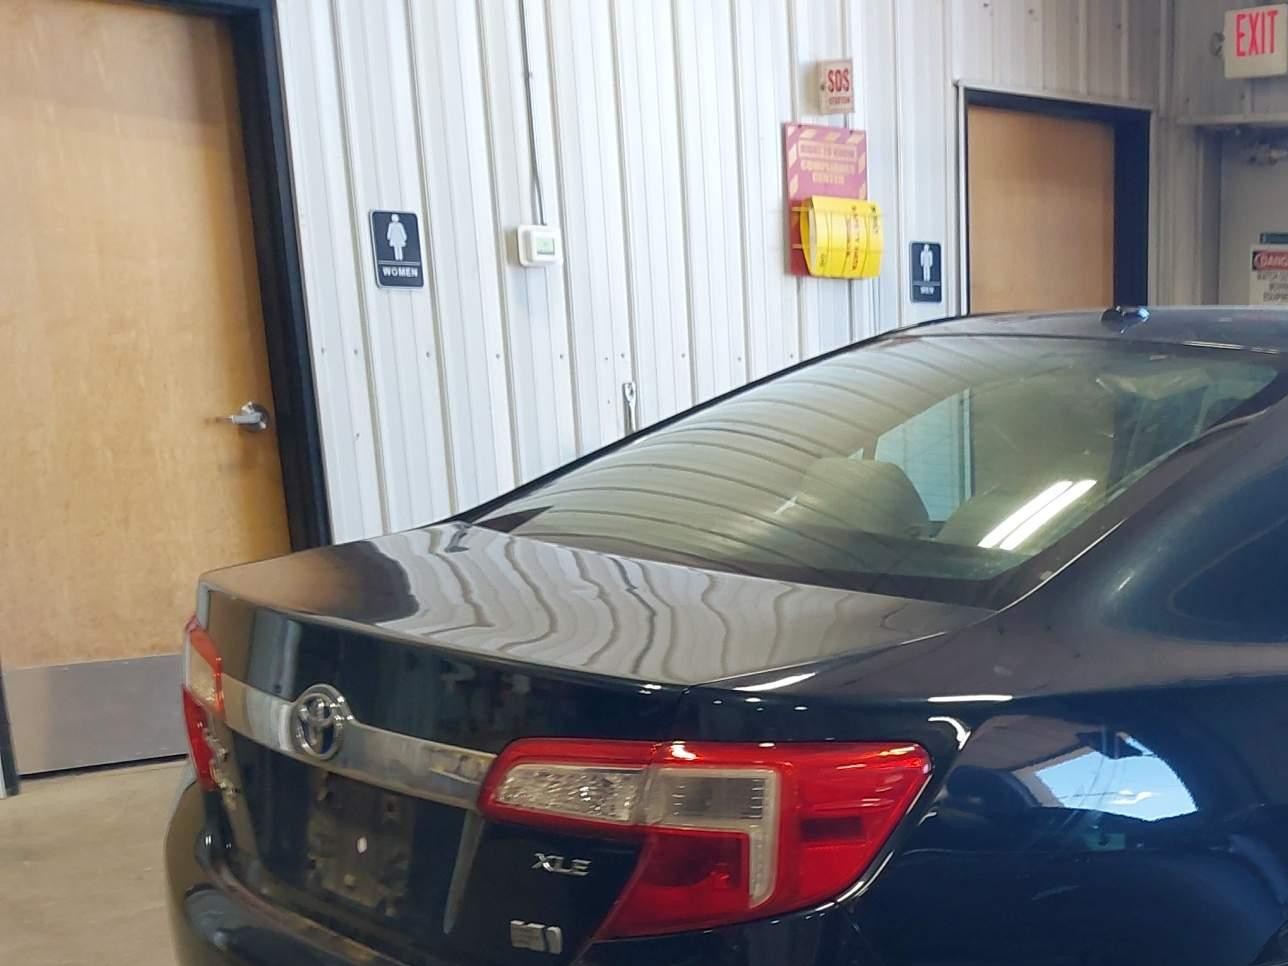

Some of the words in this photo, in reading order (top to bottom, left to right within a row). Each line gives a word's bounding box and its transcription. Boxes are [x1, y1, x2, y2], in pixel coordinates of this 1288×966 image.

[1234, 9, 1279, 57] EXIT
[382, 266, 418, 279] WOMEN
[531, 852, 591, 876] XLE
